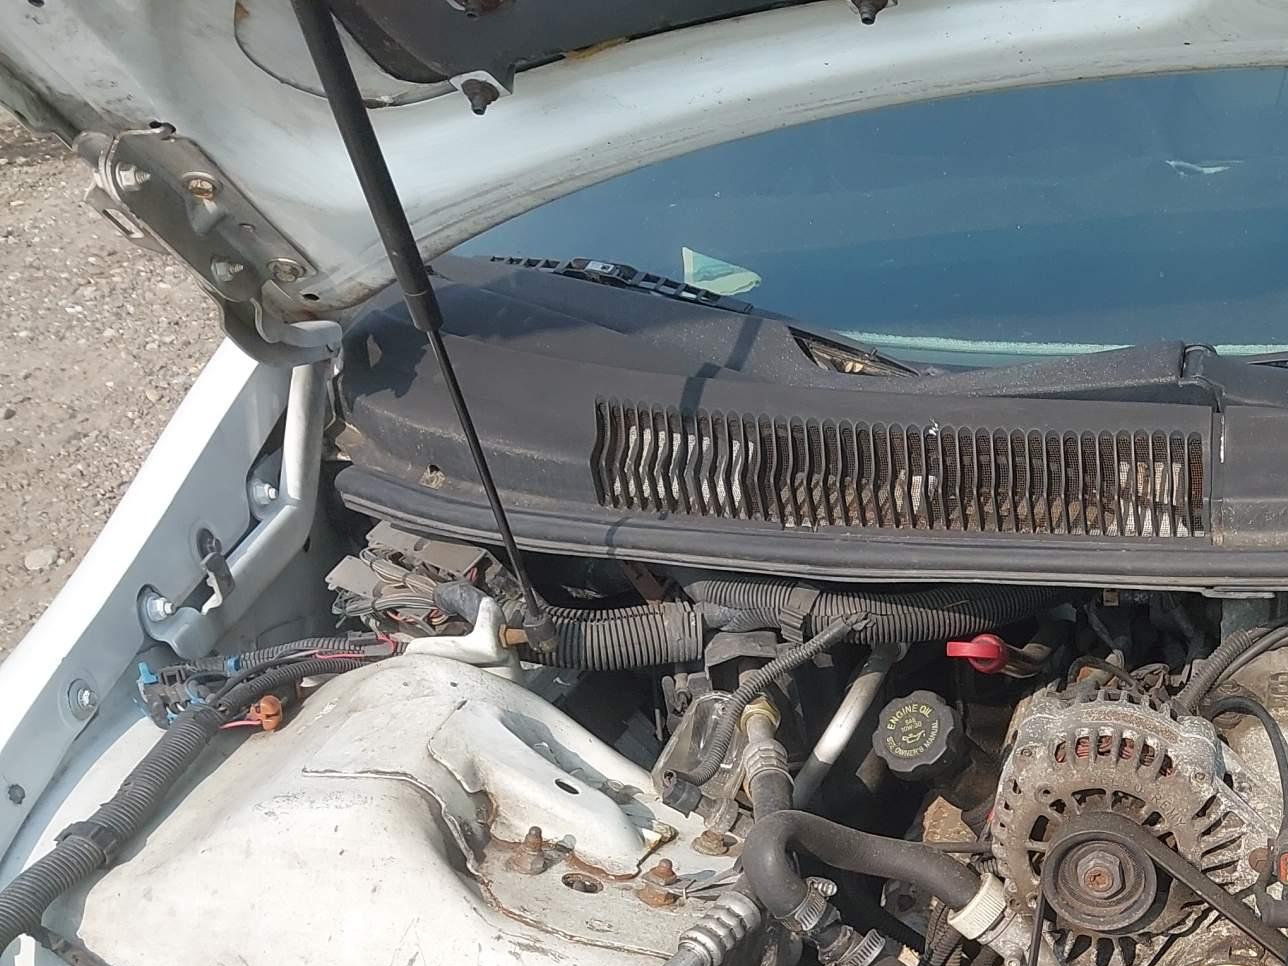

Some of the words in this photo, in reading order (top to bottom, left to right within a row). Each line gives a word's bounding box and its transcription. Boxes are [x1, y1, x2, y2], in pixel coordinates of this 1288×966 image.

[887, 704, 918, 730] ENGINE
[920, 705, 932, 718] OIL
[924, 720, 938, 748] MANUAL
